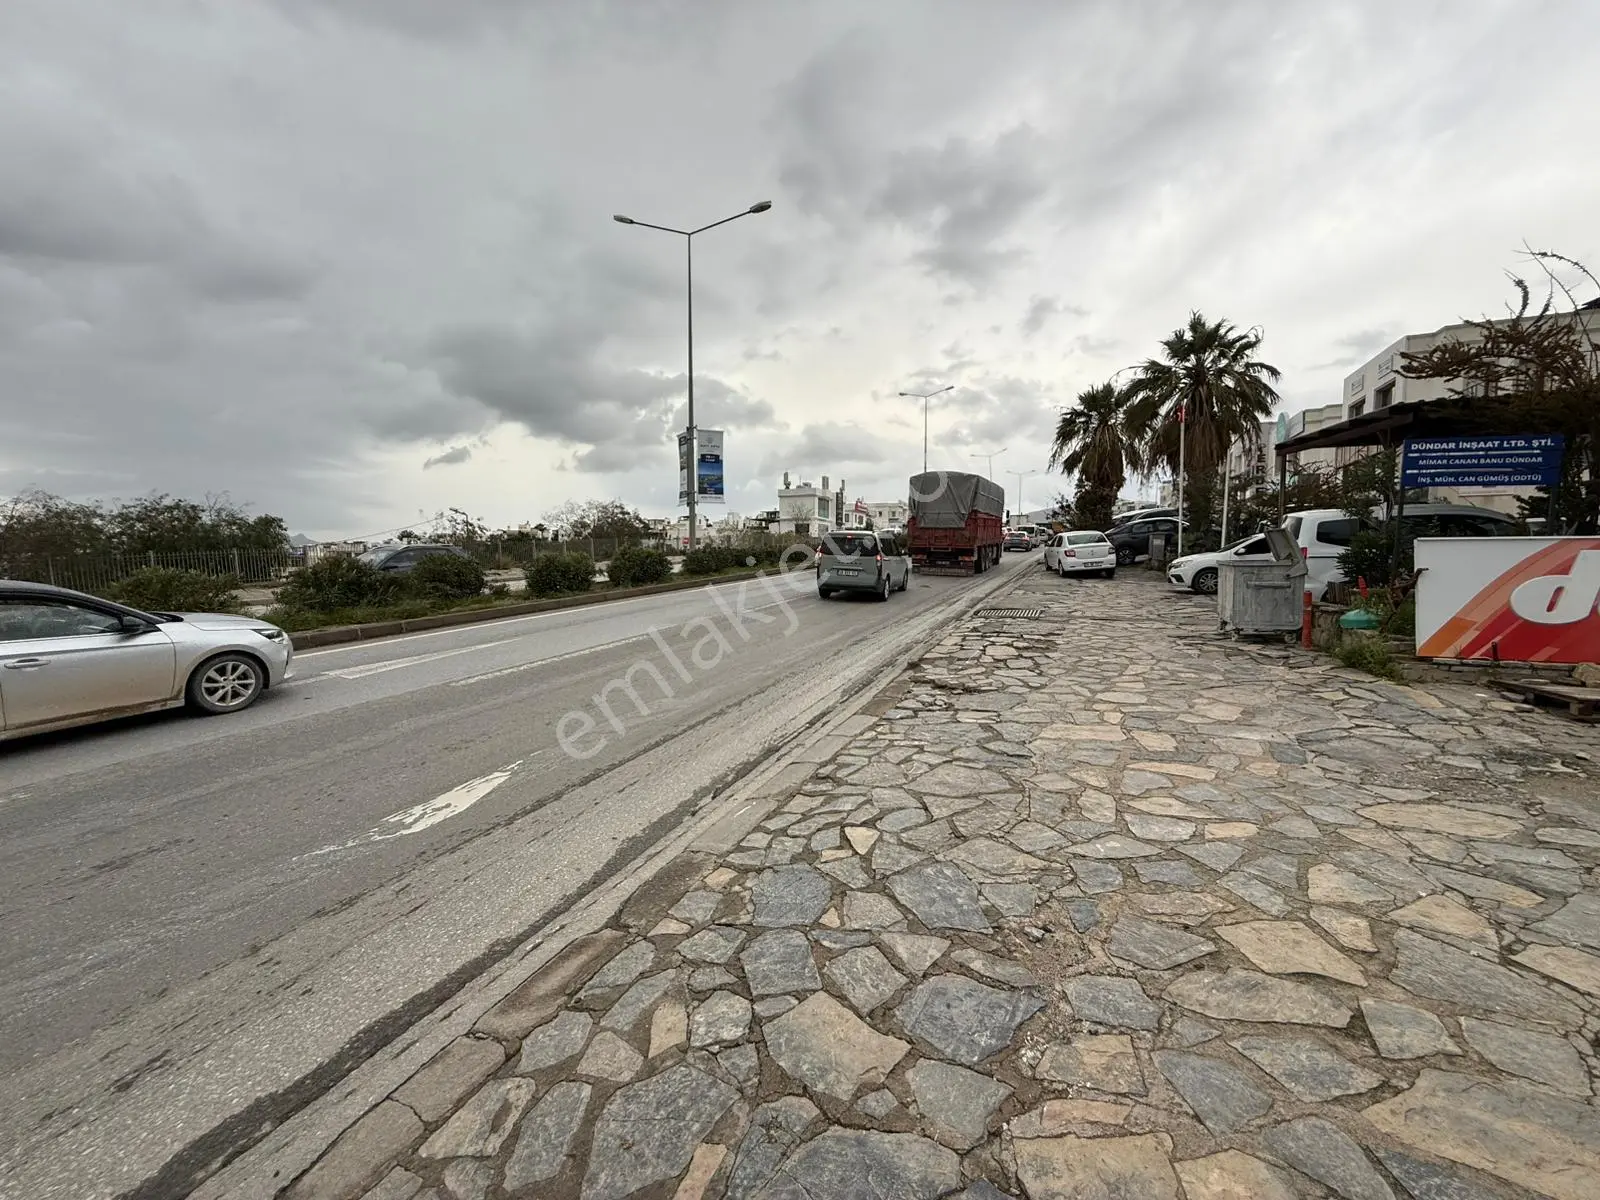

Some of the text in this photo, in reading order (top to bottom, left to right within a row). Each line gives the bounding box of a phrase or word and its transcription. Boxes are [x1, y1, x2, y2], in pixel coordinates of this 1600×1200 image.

[1411, 442, 1456, 450] DÜNDAR
[1459, 440, 1500, 449] İNŞAAT
[1531, 437, 1555, 447] ŞTİ.
[1417, 476, 1432, 484] İNŞ.
[1477, 474, 1509, 482] GÜMÜŞ
[1510, 549, 1600, 624] d
